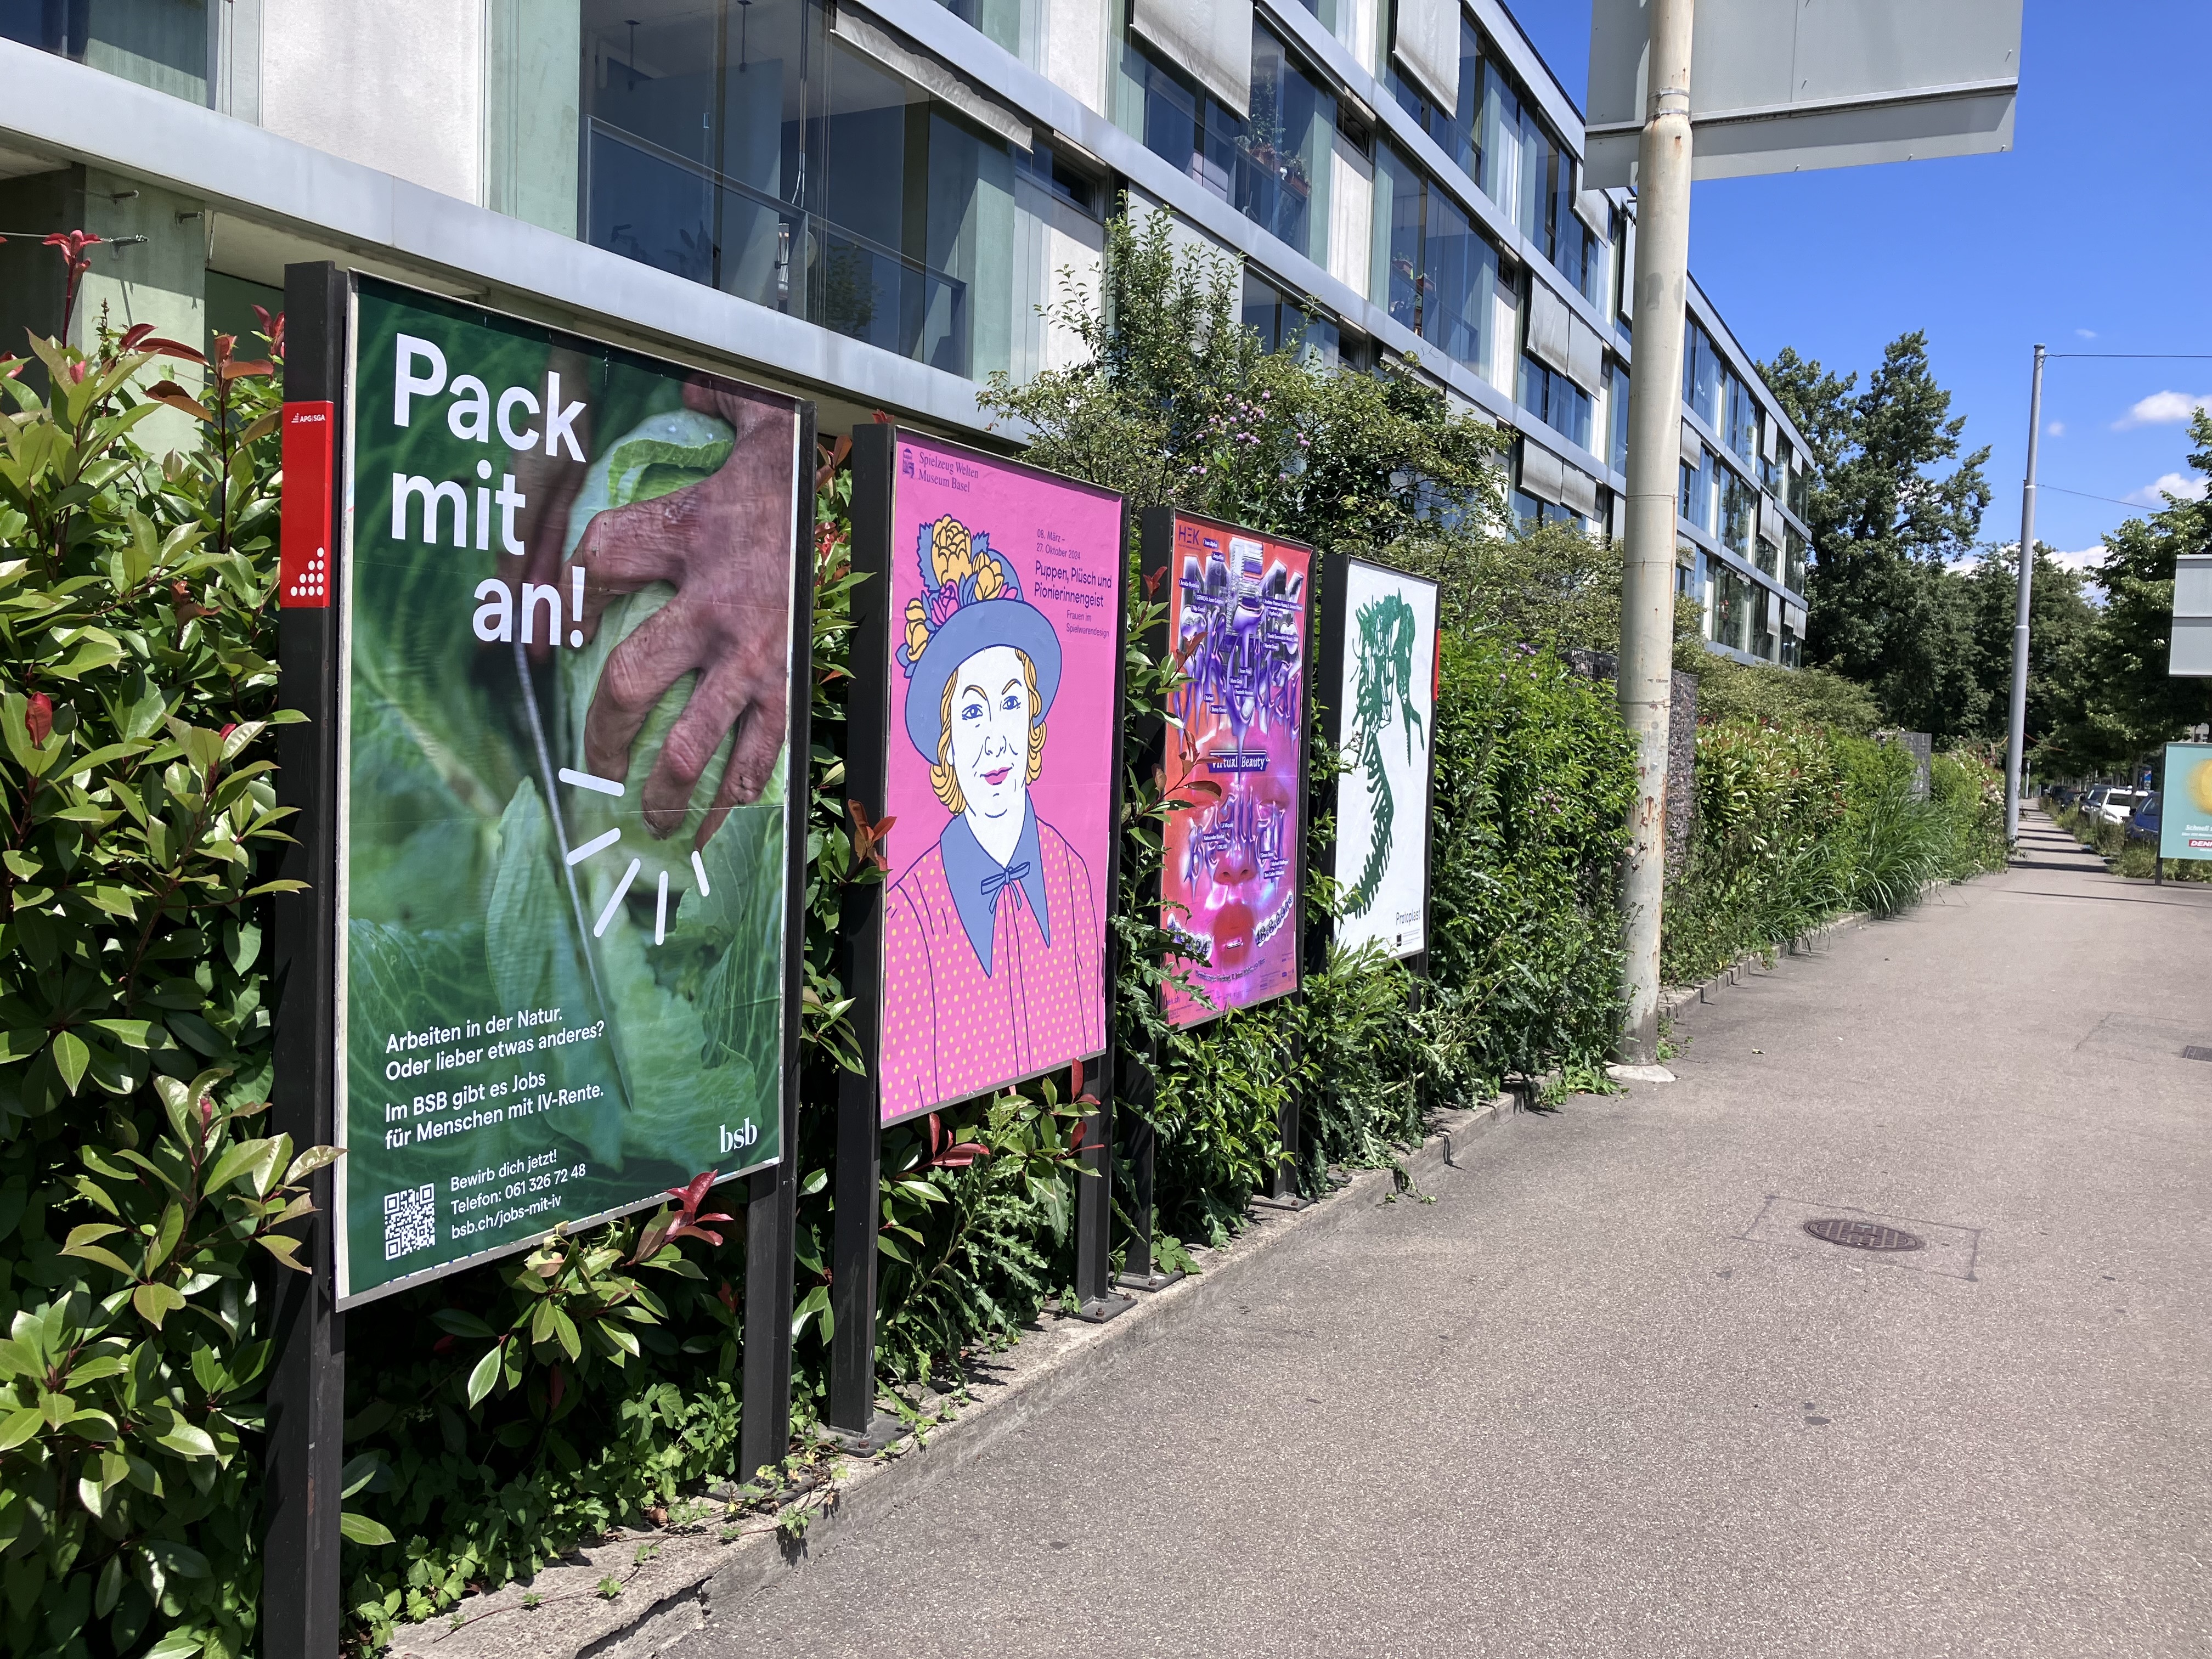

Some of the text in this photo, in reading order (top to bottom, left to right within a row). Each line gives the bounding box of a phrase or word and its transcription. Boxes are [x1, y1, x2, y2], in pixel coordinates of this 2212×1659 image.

[394, 332, 586, 462] Pack
[918, 469, 970, 493] Museum Basel
[919, 452, 979, 478] Spielzeug Welten
[392, 459, 526, 555] mit
[1047, 531, 1060, 543] März
[1179, 525, 1199, 545] HEK
[1045, 544, 1067, 557] Oktober
[1068, 549, 1081, 560] 2024
[1035, 560, 1112, 588] Puppen, Plüsch und
[472, 566, 585, 647] an!
[1034, 582, 1104, 608] Pionierinnengeist
[1066, 610, 1084, 620] Frauen
[1066, 623, 1109, 639] Spielwarendesign
[1242, 756, 1265, 770] Beauty
[1396, 907, 1420, 926] Protoplast
[385, 1007, 562, 1053] Arbeiten in der Natur.
[386, 1020, 604, 1080] Oder lieber etwas anderes?
[386, 1071, 546, 1123] Im BSB gibt es Jobs
[385, 1083, 603, 1150] für Menschen mit IV-Rente.
[719, 1117, 757, 1154] bsb
[450, 1148, 557, 1192] Bewirb dich jetzt!
[450, 1163, 586, 1215] Telefon: 061 326 72 48
[451, 1193, 562, 1239] bsb.ch/jobs-mit-iv
